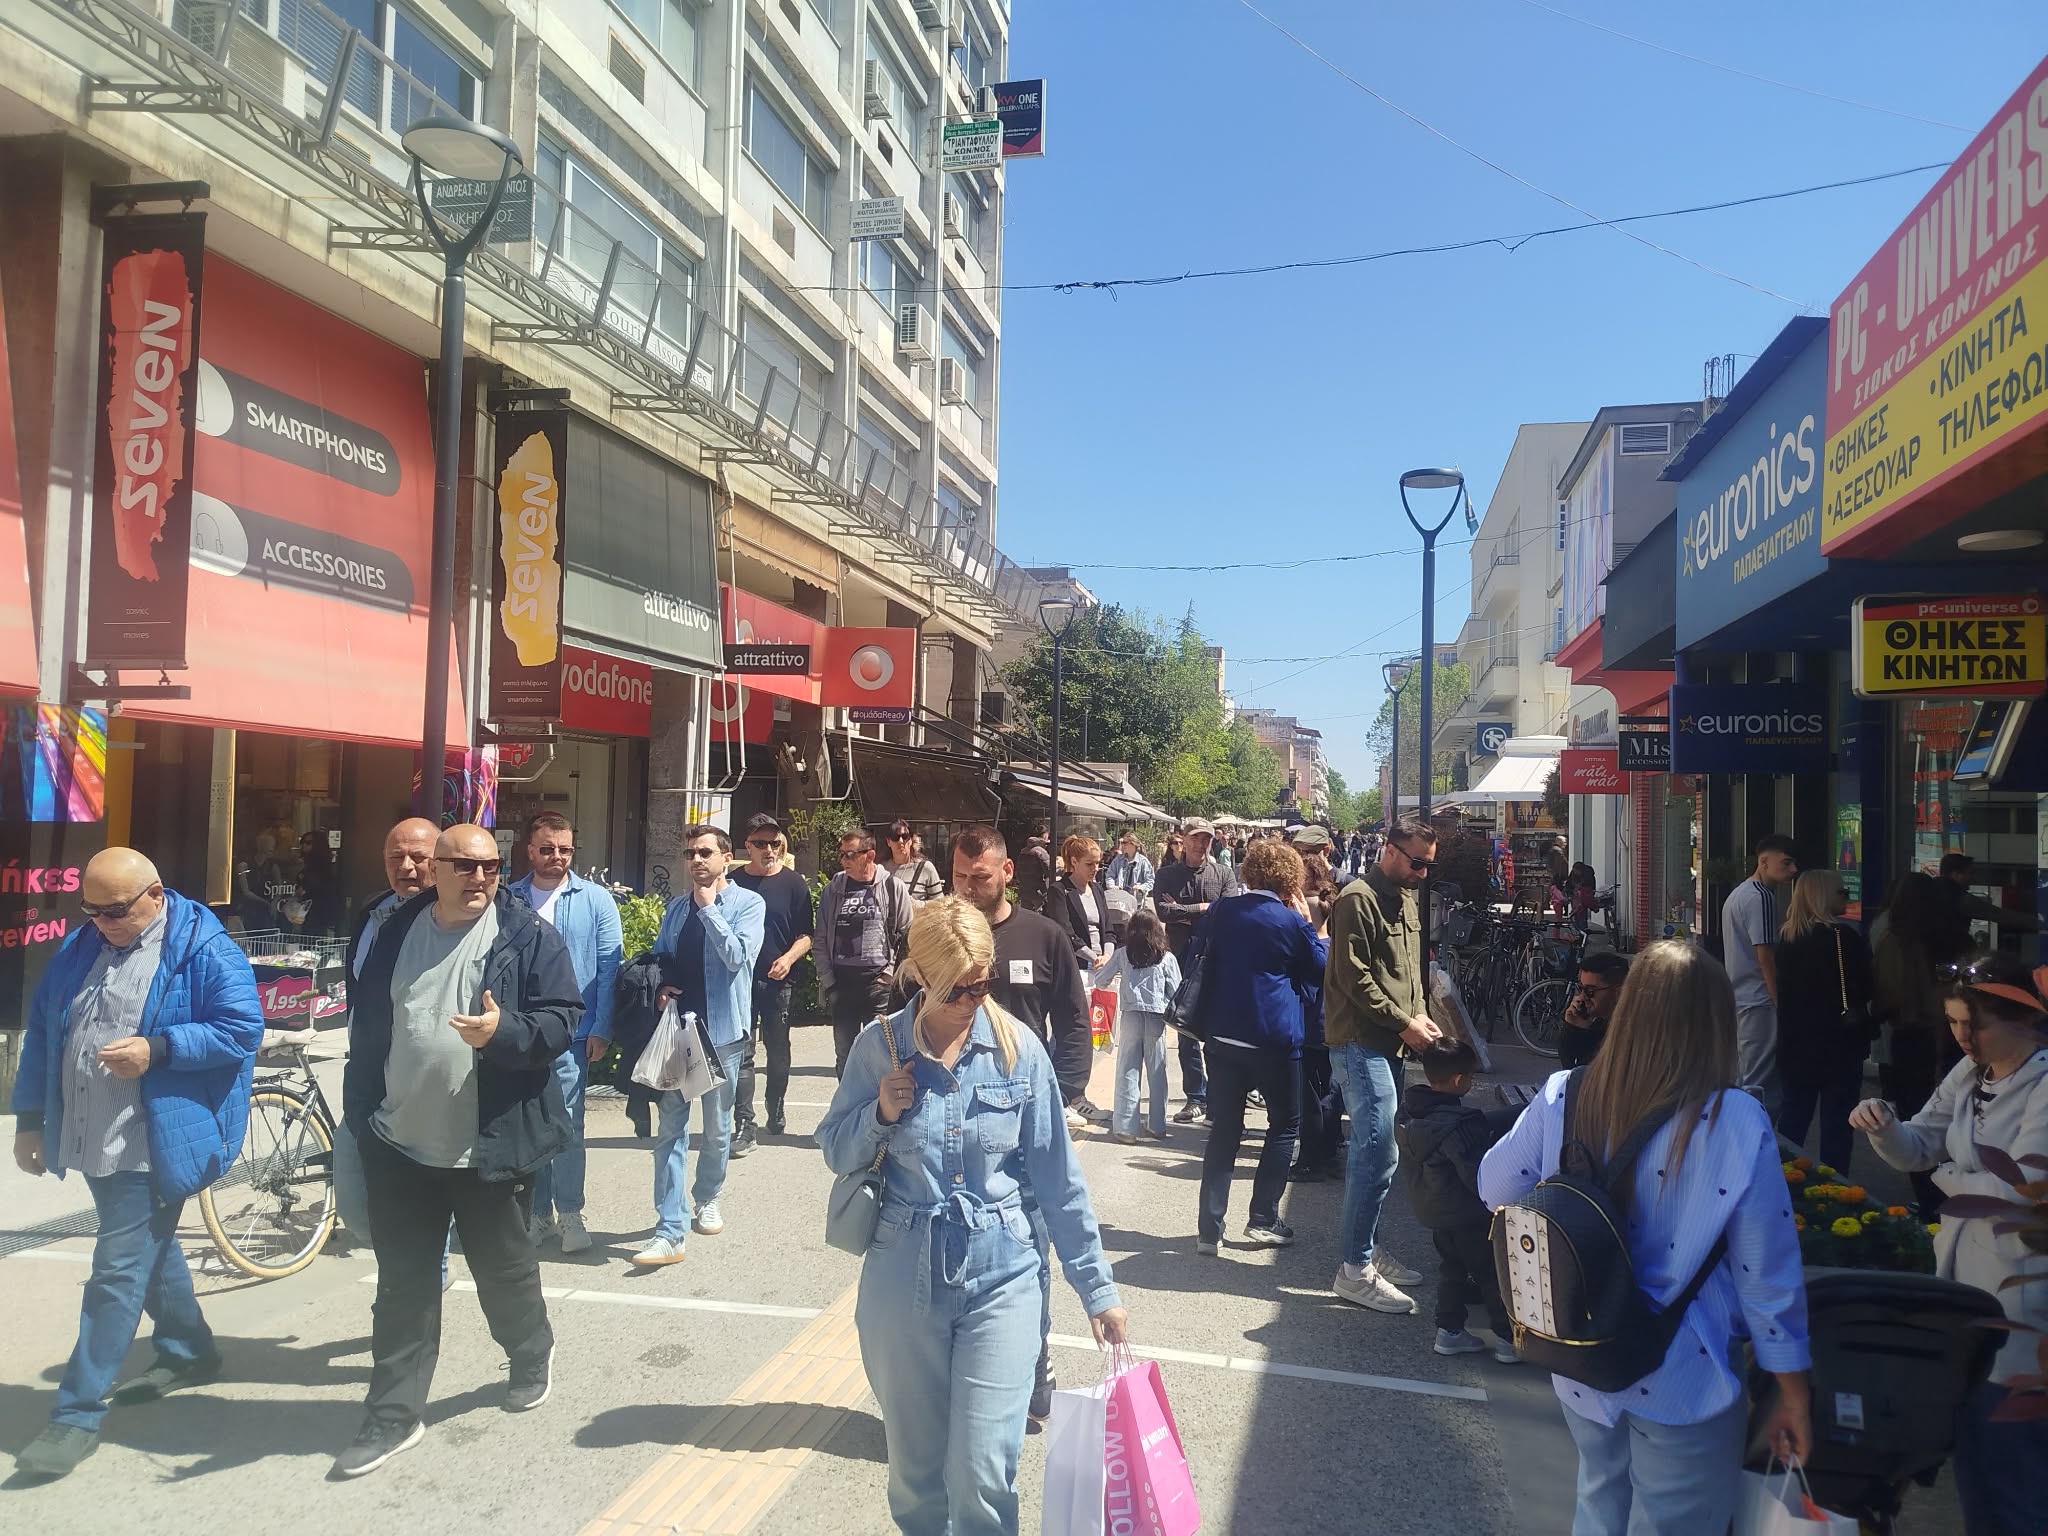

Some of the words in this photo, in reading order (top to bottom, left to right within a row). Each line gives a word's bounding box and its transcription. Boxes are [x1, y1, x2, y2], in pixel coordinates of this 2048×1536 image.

[1018, 93, 1038, 104] ONE
[947, 135, 998, 149] ΤΡΙΑΝΤΑΦΥΛΛΟΥ
[436, 183, 472, 198] ΑΝΔΡΕΑΣ
[448, 209, 514, 225] ΔΙΚΗΓΟΣ
[1834, 281, 1868, 393] PC
[1853, 333, 1919, 410] ΣΙΩΚΟΣ
[1925, 223, 2040, 349] ΚΩΝ/ΝΟΣ
[1939, 296, 2028, 399] ΚΙΝΗΤΑ
[1938, 340, 2048, 457] ΤΗΛΕΦΩ
[246, 401, 387, 474] SMARTPHONES
[1835, 403, 1889, 475] ΘΗΚΕΣ
[1695, 414, 1815, 570] euronics
[1832, 435, 1921, 526] ΑΞΕΣΟΥΑΡ
[262, 537, 387, 590] ACCESSORIES
[1733, 506, 1815, 585] ΠΑΠΑΕΥΑΓΓΕΛΟΥ
[644, 588, 710, 632] attrattivo
[1918, 602, 2019, 616] pc-universe
[1885, 620, 2026, 650] ΘΗΚΕΣ
[734, 651, 805, 667] attrattivo
[1883, 654, 2027, 680] ΚΙΝΗΤΩΝ
[561, 660, 652, 705] vodafone
[852, 710, 906, 722] #ομάδαReady
[1697, 708, 1824, 734] euronics
